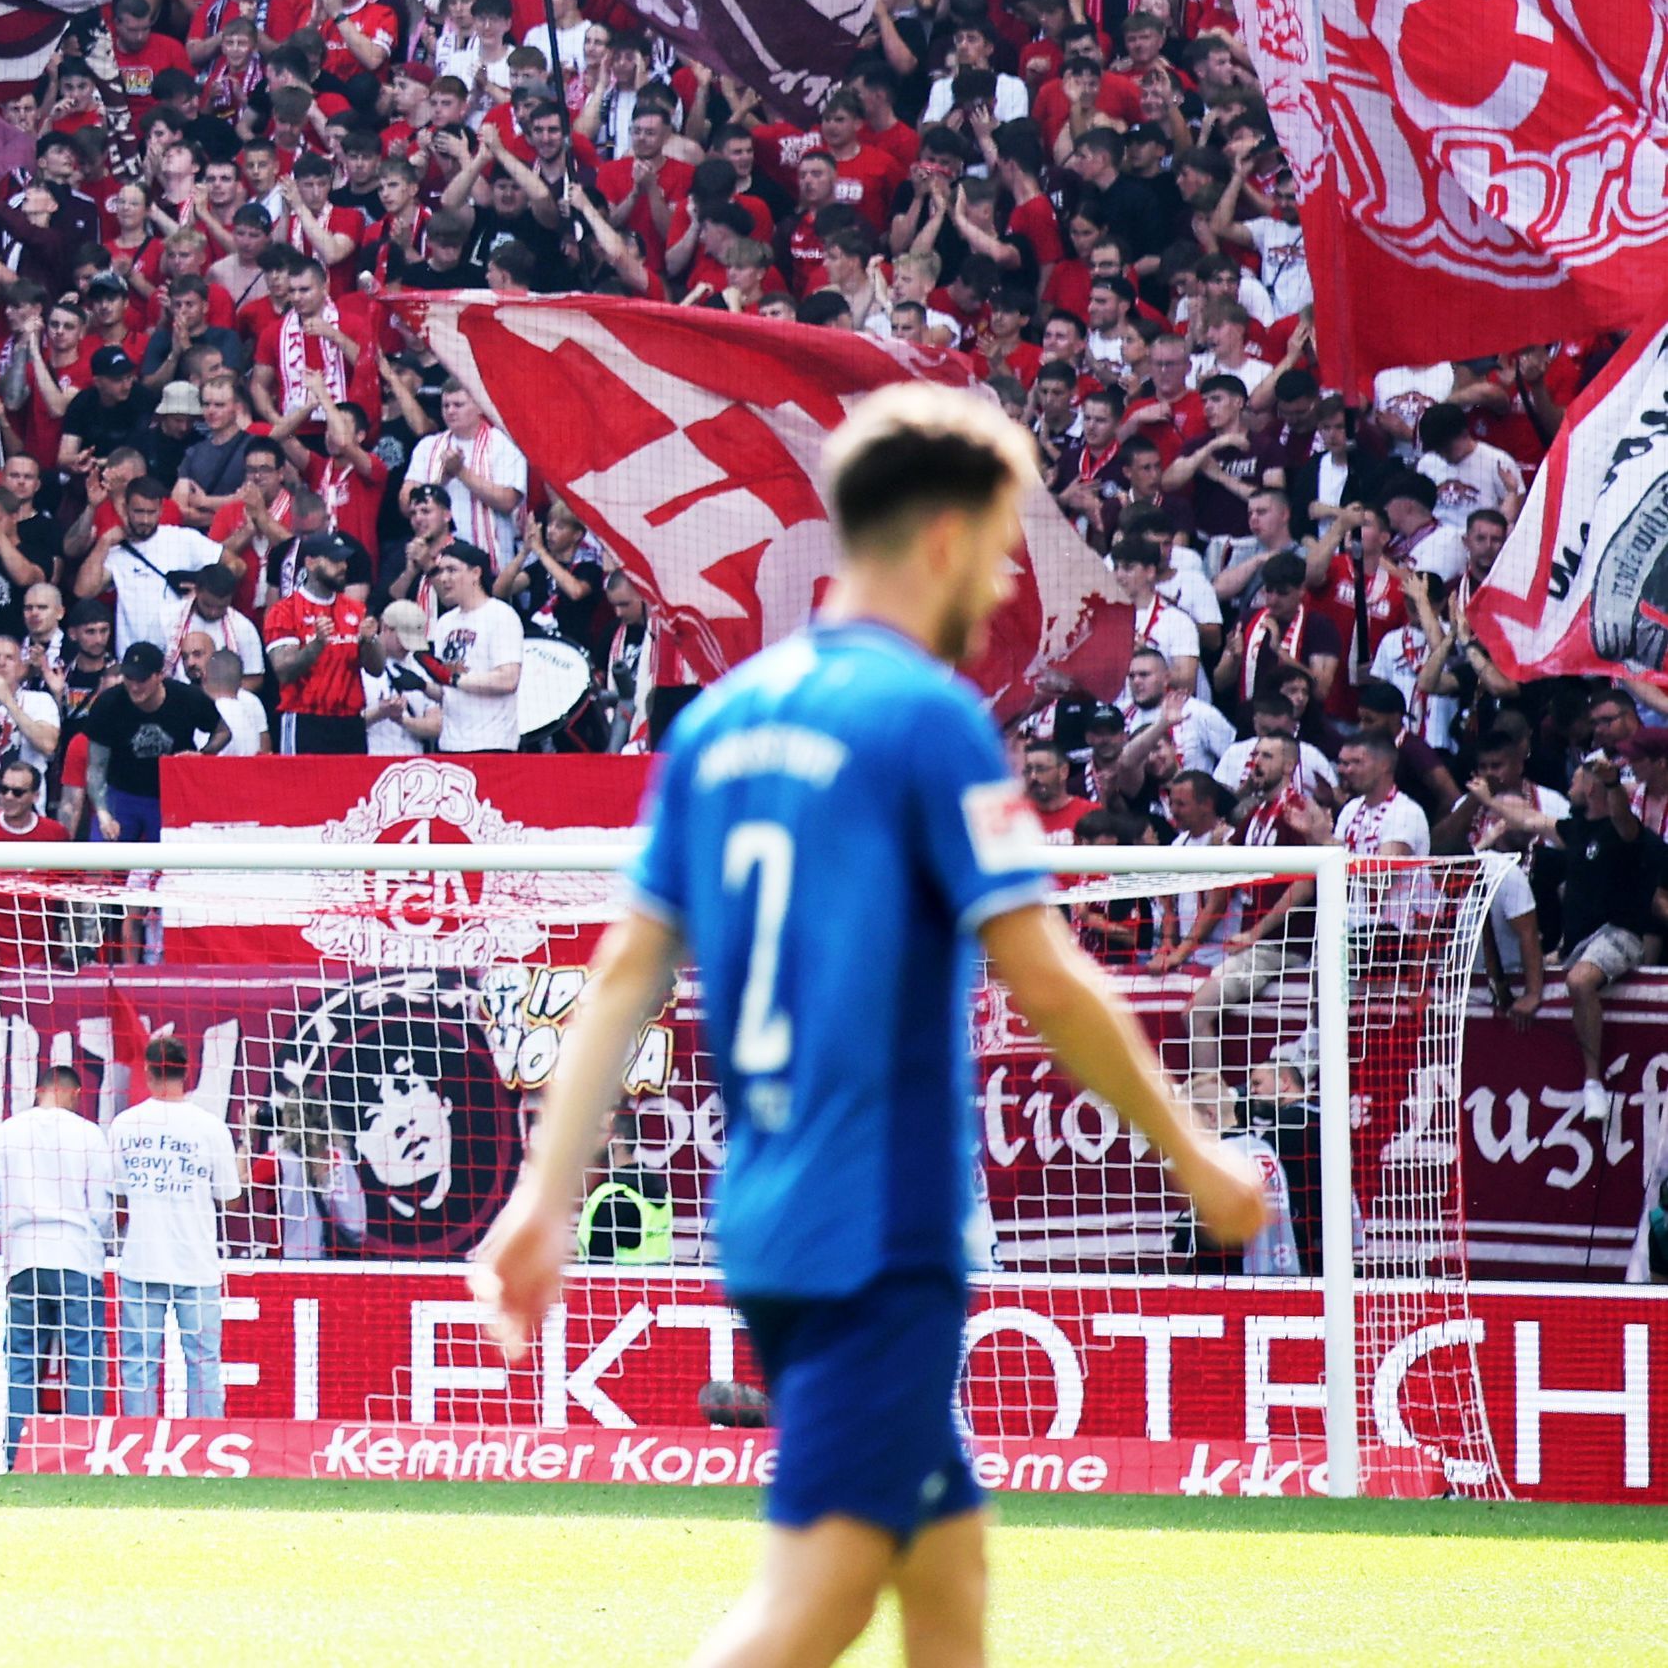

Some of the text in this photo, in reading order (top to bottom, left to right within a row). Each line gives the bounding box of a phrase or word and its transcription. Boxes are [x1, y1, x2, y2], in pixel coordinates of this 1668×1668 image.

[379, 769, 475, 820] 125
[722, 821, 796, 1076] 2
[119, 1134, 153, 1152] Live
[168, 1295, 1651, 1487] ELEKTOTECH
[84, 1420, 255, 1479] kks
[323, 1427, 595, 1483] Kemmler
[609, 1436, 1108, 1494] Kopieeme
